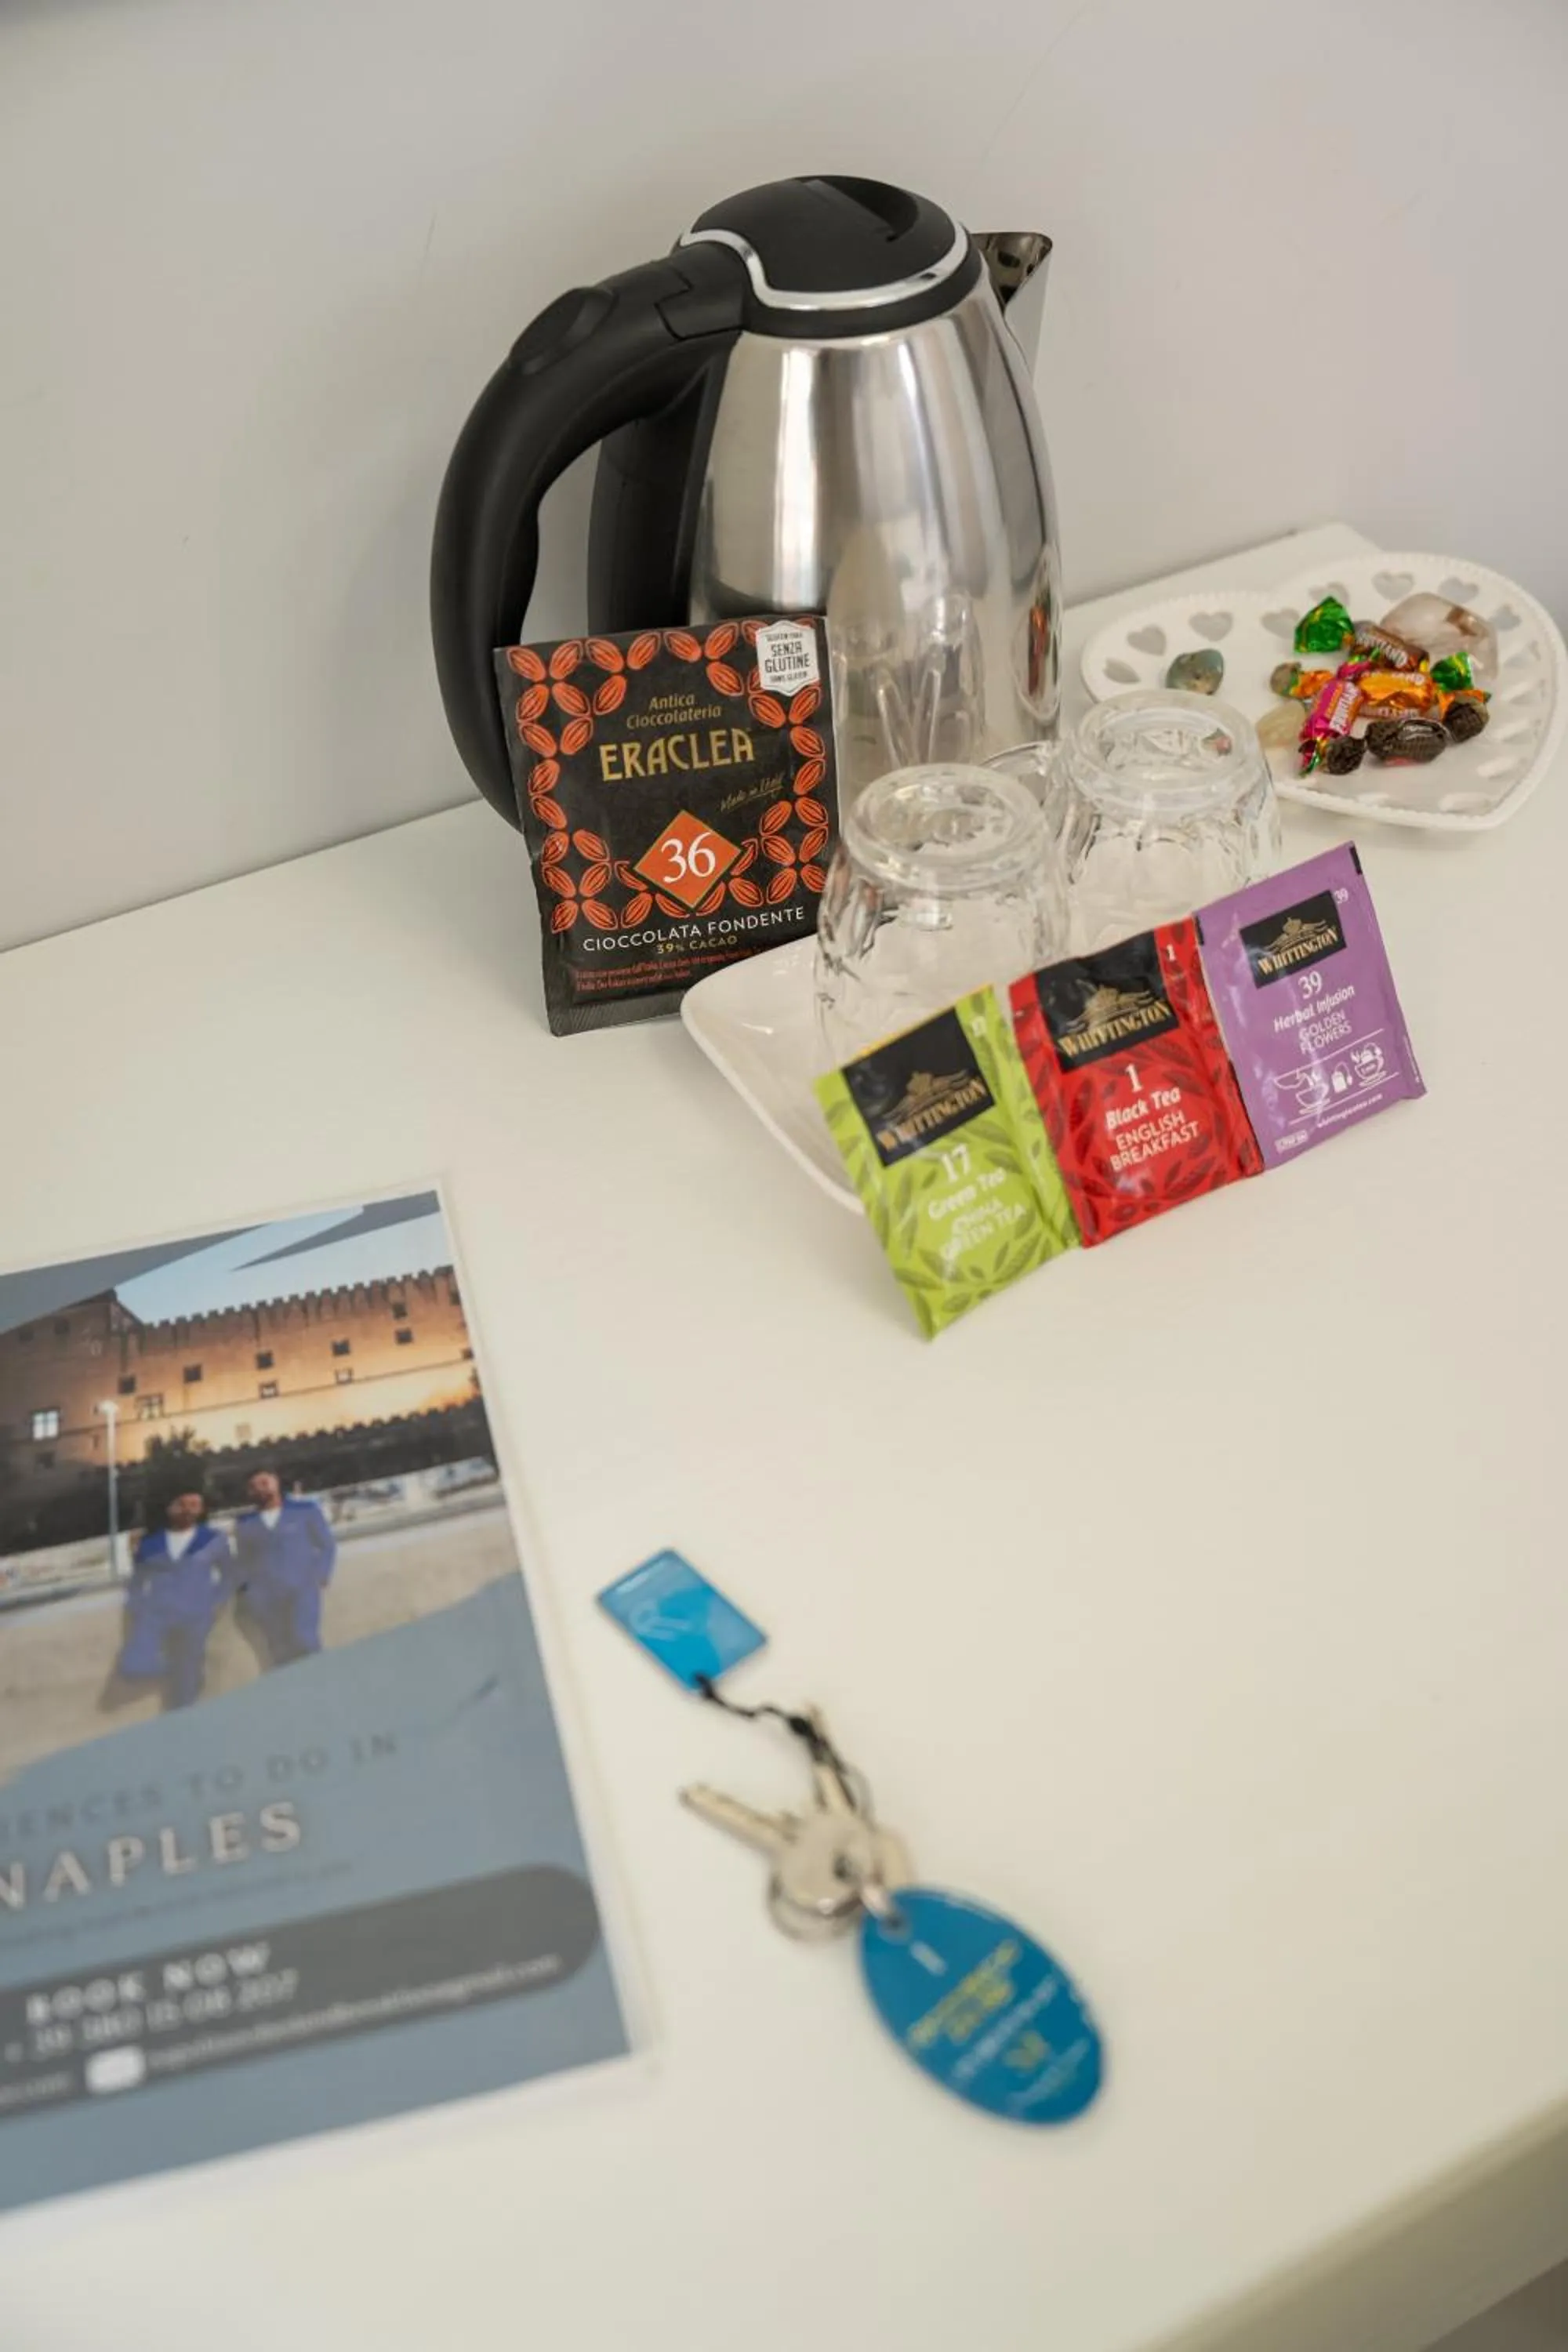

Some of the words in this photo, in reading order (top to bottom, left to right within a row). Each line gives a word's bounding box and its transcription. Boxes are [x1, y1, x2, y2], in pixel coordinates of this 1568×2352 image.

[765, 652, 810, 673] GLUTINE
[771, 641, 802, 657] SENZA
[626, 705, 722, 730] Cioccolateria
[649, 693, 695, 711] Antica
[599, 728, 755, 782] ERACLEA
[661, 832, 717, 883] 36
[1334, 887, 1348, 904] 39
[583, 924, 702, 952] CIOCCOLATA
[708, 906, 805, 934] FONDENTE
[656, 942, 684, 955] 39%
[689, 935, 738, 950] CACAO
[1258, 927, 1339, 975] WHITTINGTON
[1298, 971, 1323, 1000] 39
[1057, 1000, 1171, 1057] WHITTINGTON
[1273, 1004, 1316, 1033] Herbal
[1317, 985, 1356, 1014] Infusion
[1299, 1010, 1346, 1041] GOLDEN
[1300, 1021, 1352, 1054] FLOWERS
[1125, 1063, 1143, 1093] 1
[1105, 1099, 1149, 1130] Black
[1151, 1087, 1181, 1109] Tea
[1110, 1121, 1198, 1172] BREAKFAST
[1116, 1110, 1185, 1150] ENGLISH
[942, 1144, 971, 1183] 17
[185, 1765, 245, 1801] TO
[267, 1745, 328, 1784] DO
[350, 1731, 399, 1765] IN
[0, 1802, 302, 1911] NAPLES
[26, 1969, 147, 2027] BOOK
[162, 1941, 271, 1991] NOW
